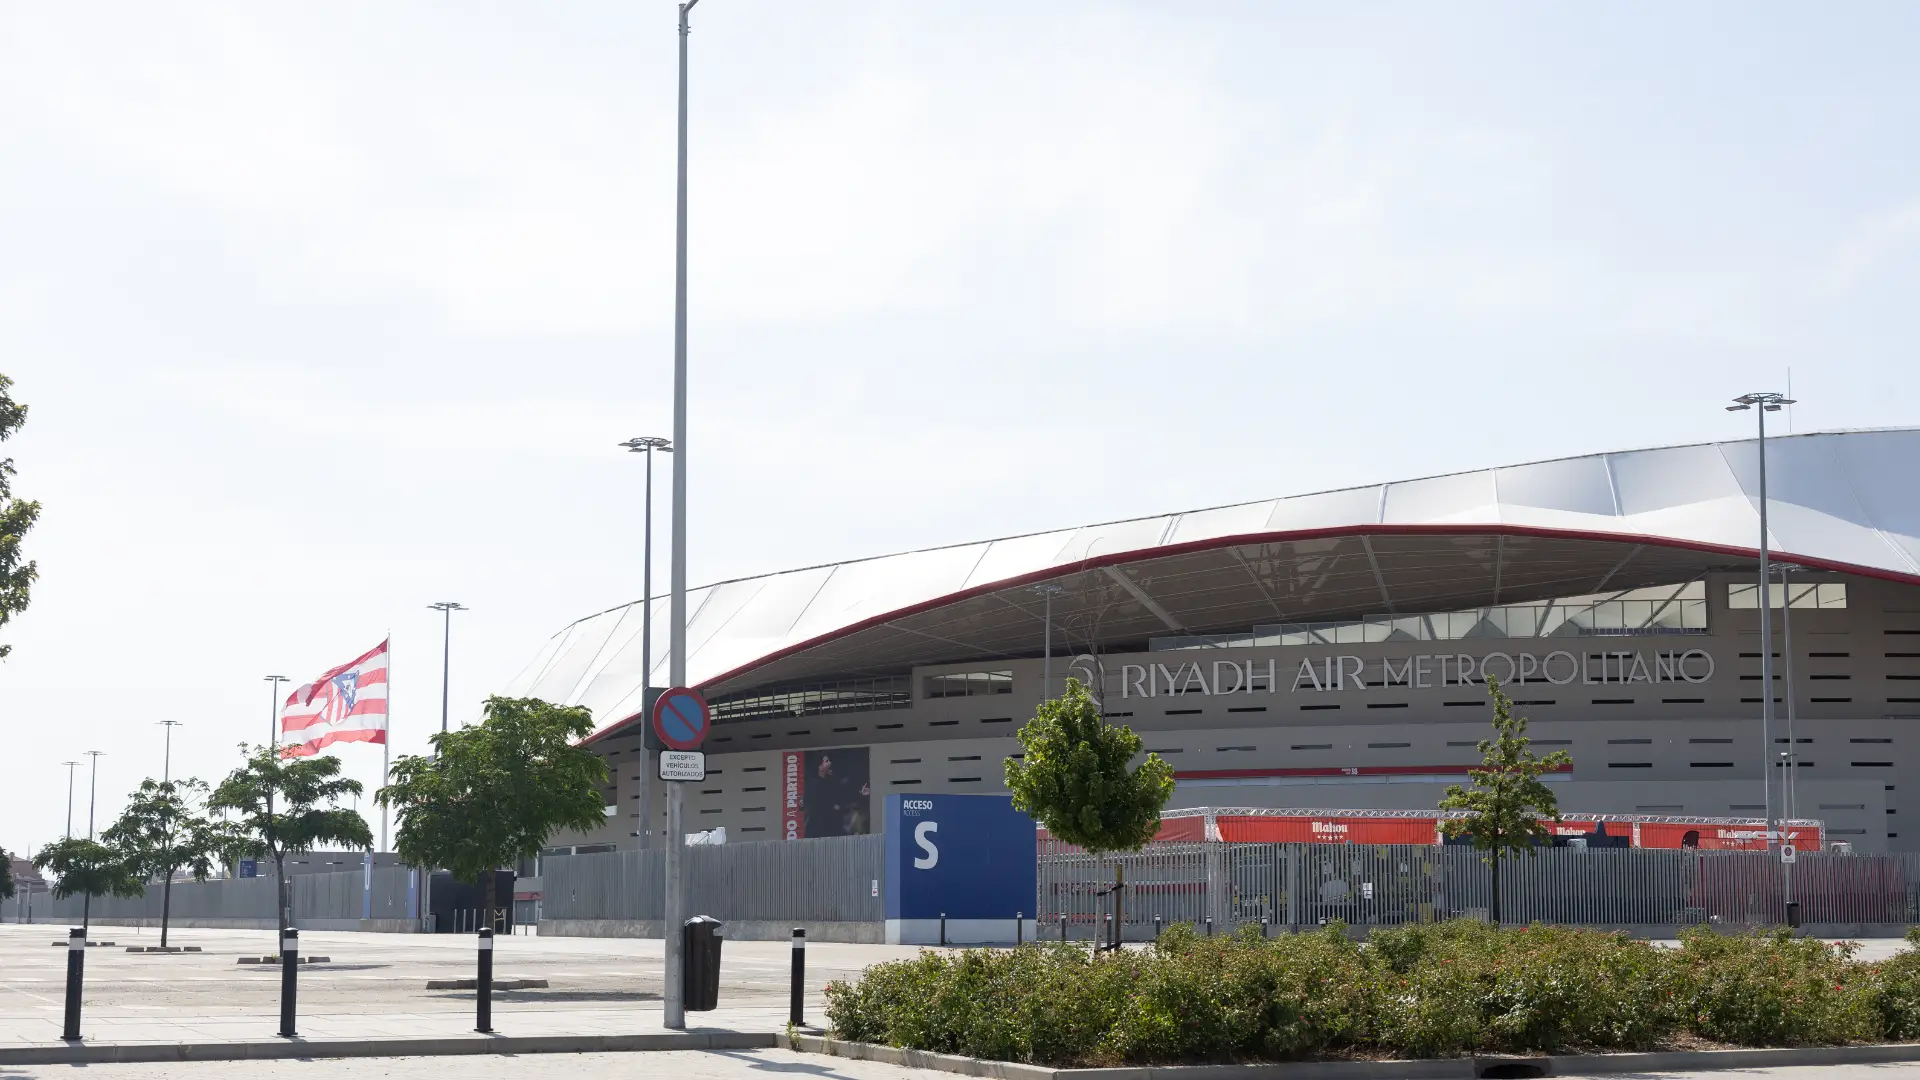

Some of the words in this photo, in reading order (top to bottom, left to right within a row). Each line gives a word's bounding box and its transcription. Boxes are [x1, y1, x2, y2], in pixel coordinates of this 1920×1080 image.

[1121, 658, 1276, 699] RIYADH
[1291, 655, 1367, 692] AIR
[1382, 648, 1715, 689] METROPOLITANO
[661, 770, 703, 778] AUTORIZADOS
[786, 754, 798, 808] PARTIDO
[903, 799, 933, 810] ACCESO
[1312, 821, 1348, 833] Mahou
[914, 821, 939, 870] S
